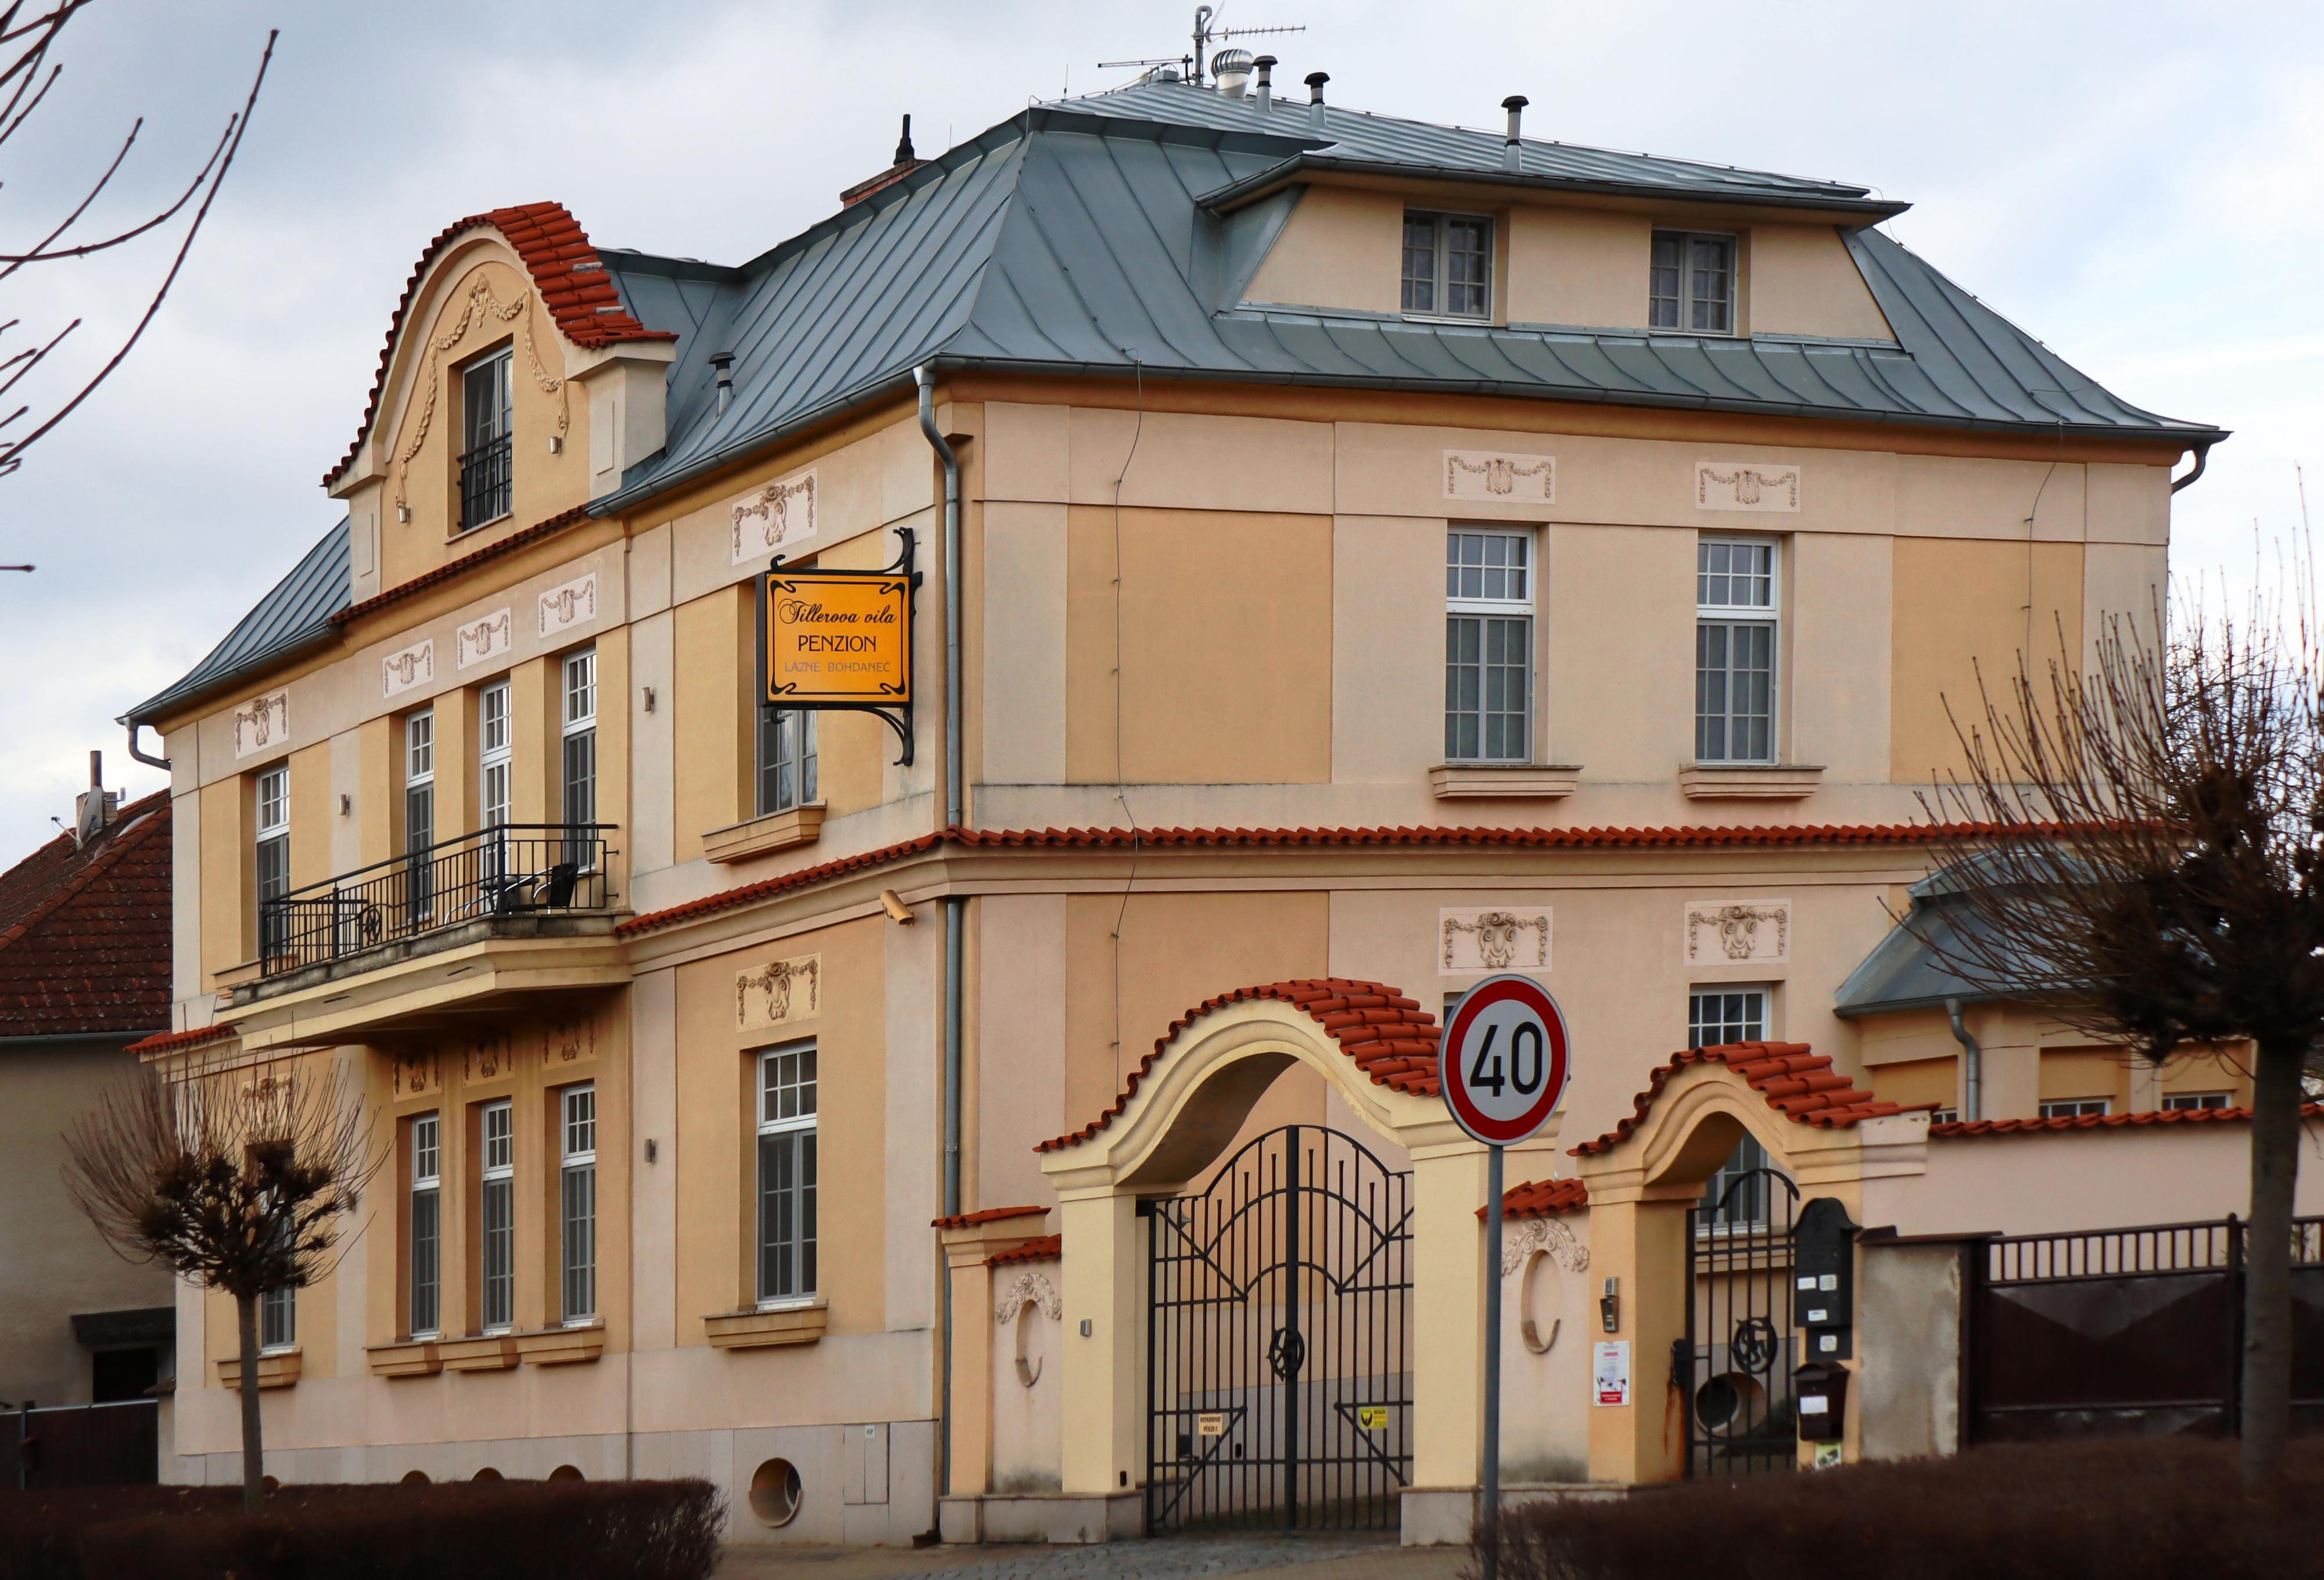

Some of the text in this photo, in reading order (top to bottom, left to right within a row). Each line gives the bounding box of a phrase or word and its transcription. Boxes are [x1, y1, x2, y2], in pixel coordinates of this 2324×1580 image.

[777, 598, 897, 624] Tillerova vila
[798, 635, 877, 652] PENZION
[1469, 1021, 1543, 1097] 40
